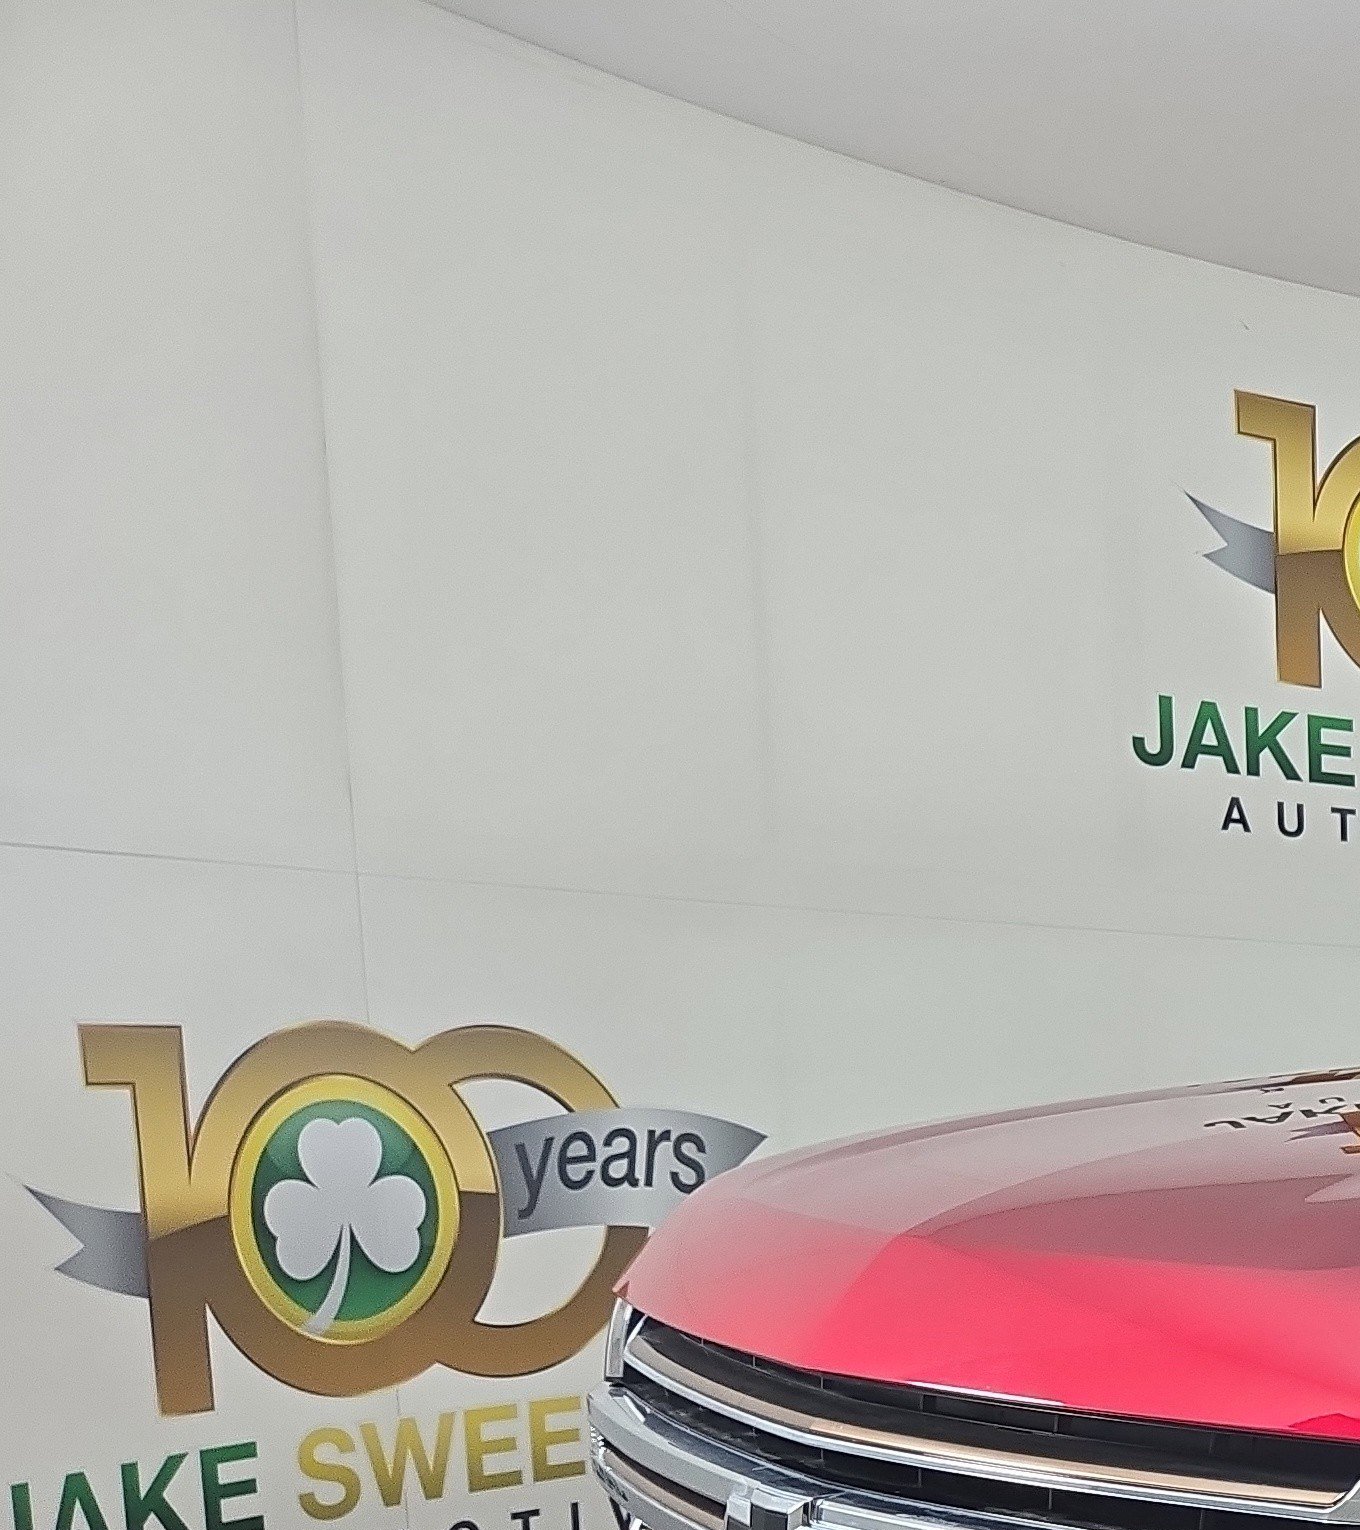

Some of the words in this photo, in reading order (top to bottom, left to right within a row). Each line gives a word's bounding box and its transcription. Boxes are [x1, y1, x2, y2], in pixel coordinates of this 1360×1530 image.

[1132, 695, 1356, 787] JAKE
[514, 1125, 707, 1220] years
[297, 1396, 589, 1523] SWEE
